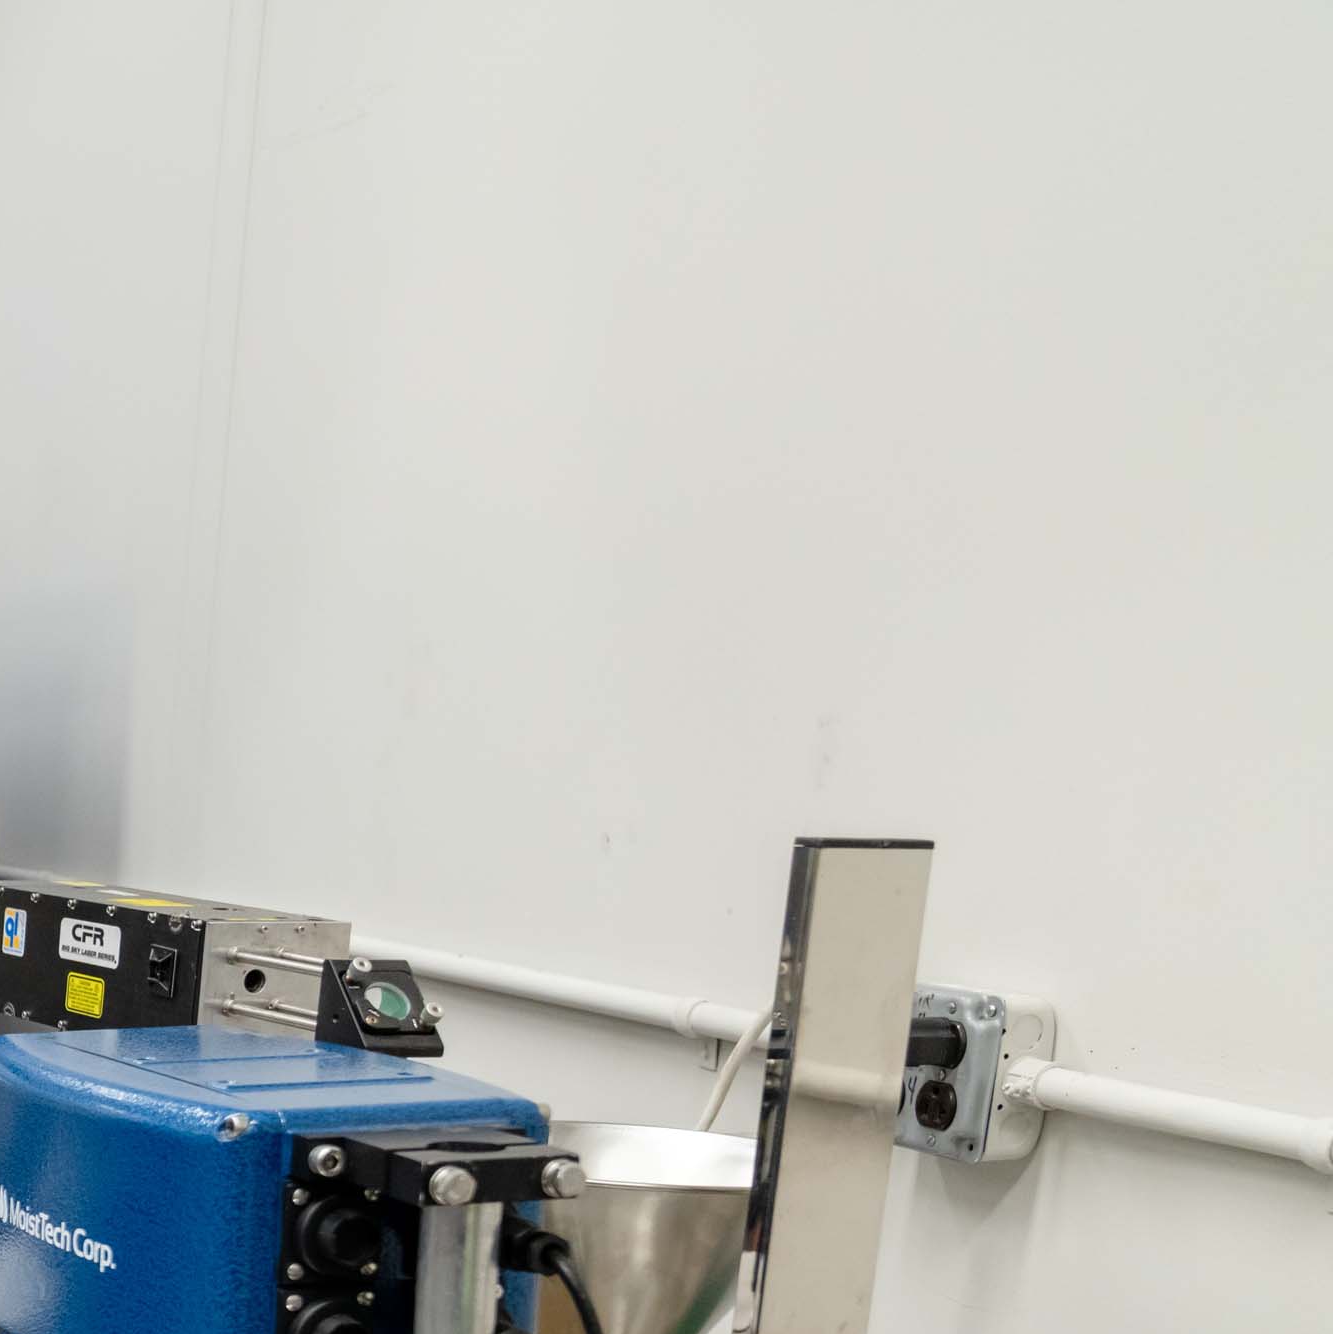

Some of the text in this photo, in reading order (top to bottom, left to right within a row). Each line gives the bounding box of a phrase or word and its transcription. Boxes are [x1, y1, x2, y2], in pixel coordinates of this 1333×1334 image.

[71, 923, 105, 947] CFR
[71, 946, 81, 954] SKY
[81, 948, 97, 958] LASER
[9, 1196, 117, 1273] MoistTech Corp.
